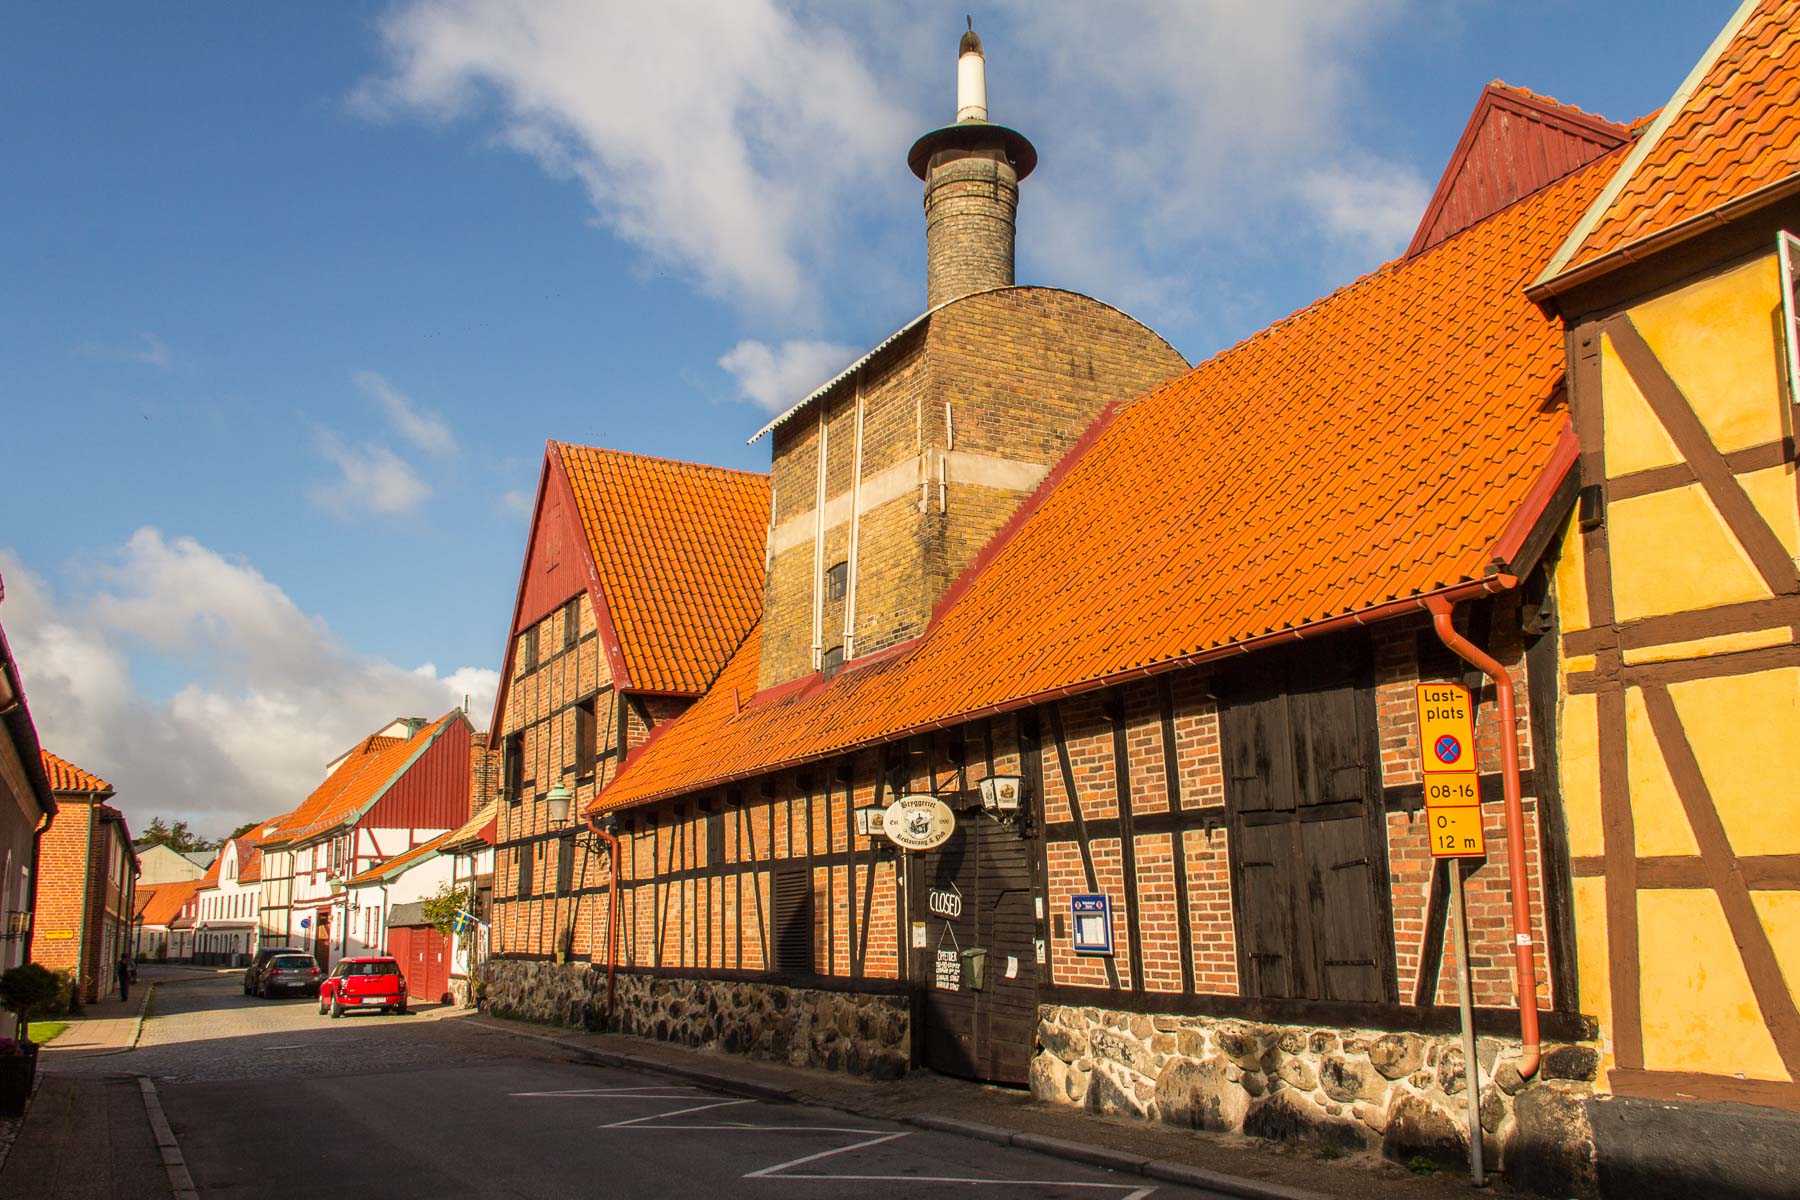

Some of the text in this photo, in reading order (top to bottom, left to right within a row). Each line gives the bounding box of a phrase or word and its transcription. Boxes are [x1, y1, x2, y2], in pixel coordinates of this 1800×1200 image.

[1424, 689, 1464, 702] Last-
[1427, 707, 1464, 722] plats
[1430, 784, 1474, 798] 08-16
[900, 800, 936, 809] Bryggeriet
[896, 833, 928, 846] Restaurang
[935, 831, 946, 841] Pub
[1438, 836, 1476, 849] 12 m
[929, 891, 961, 917] CLOSED
